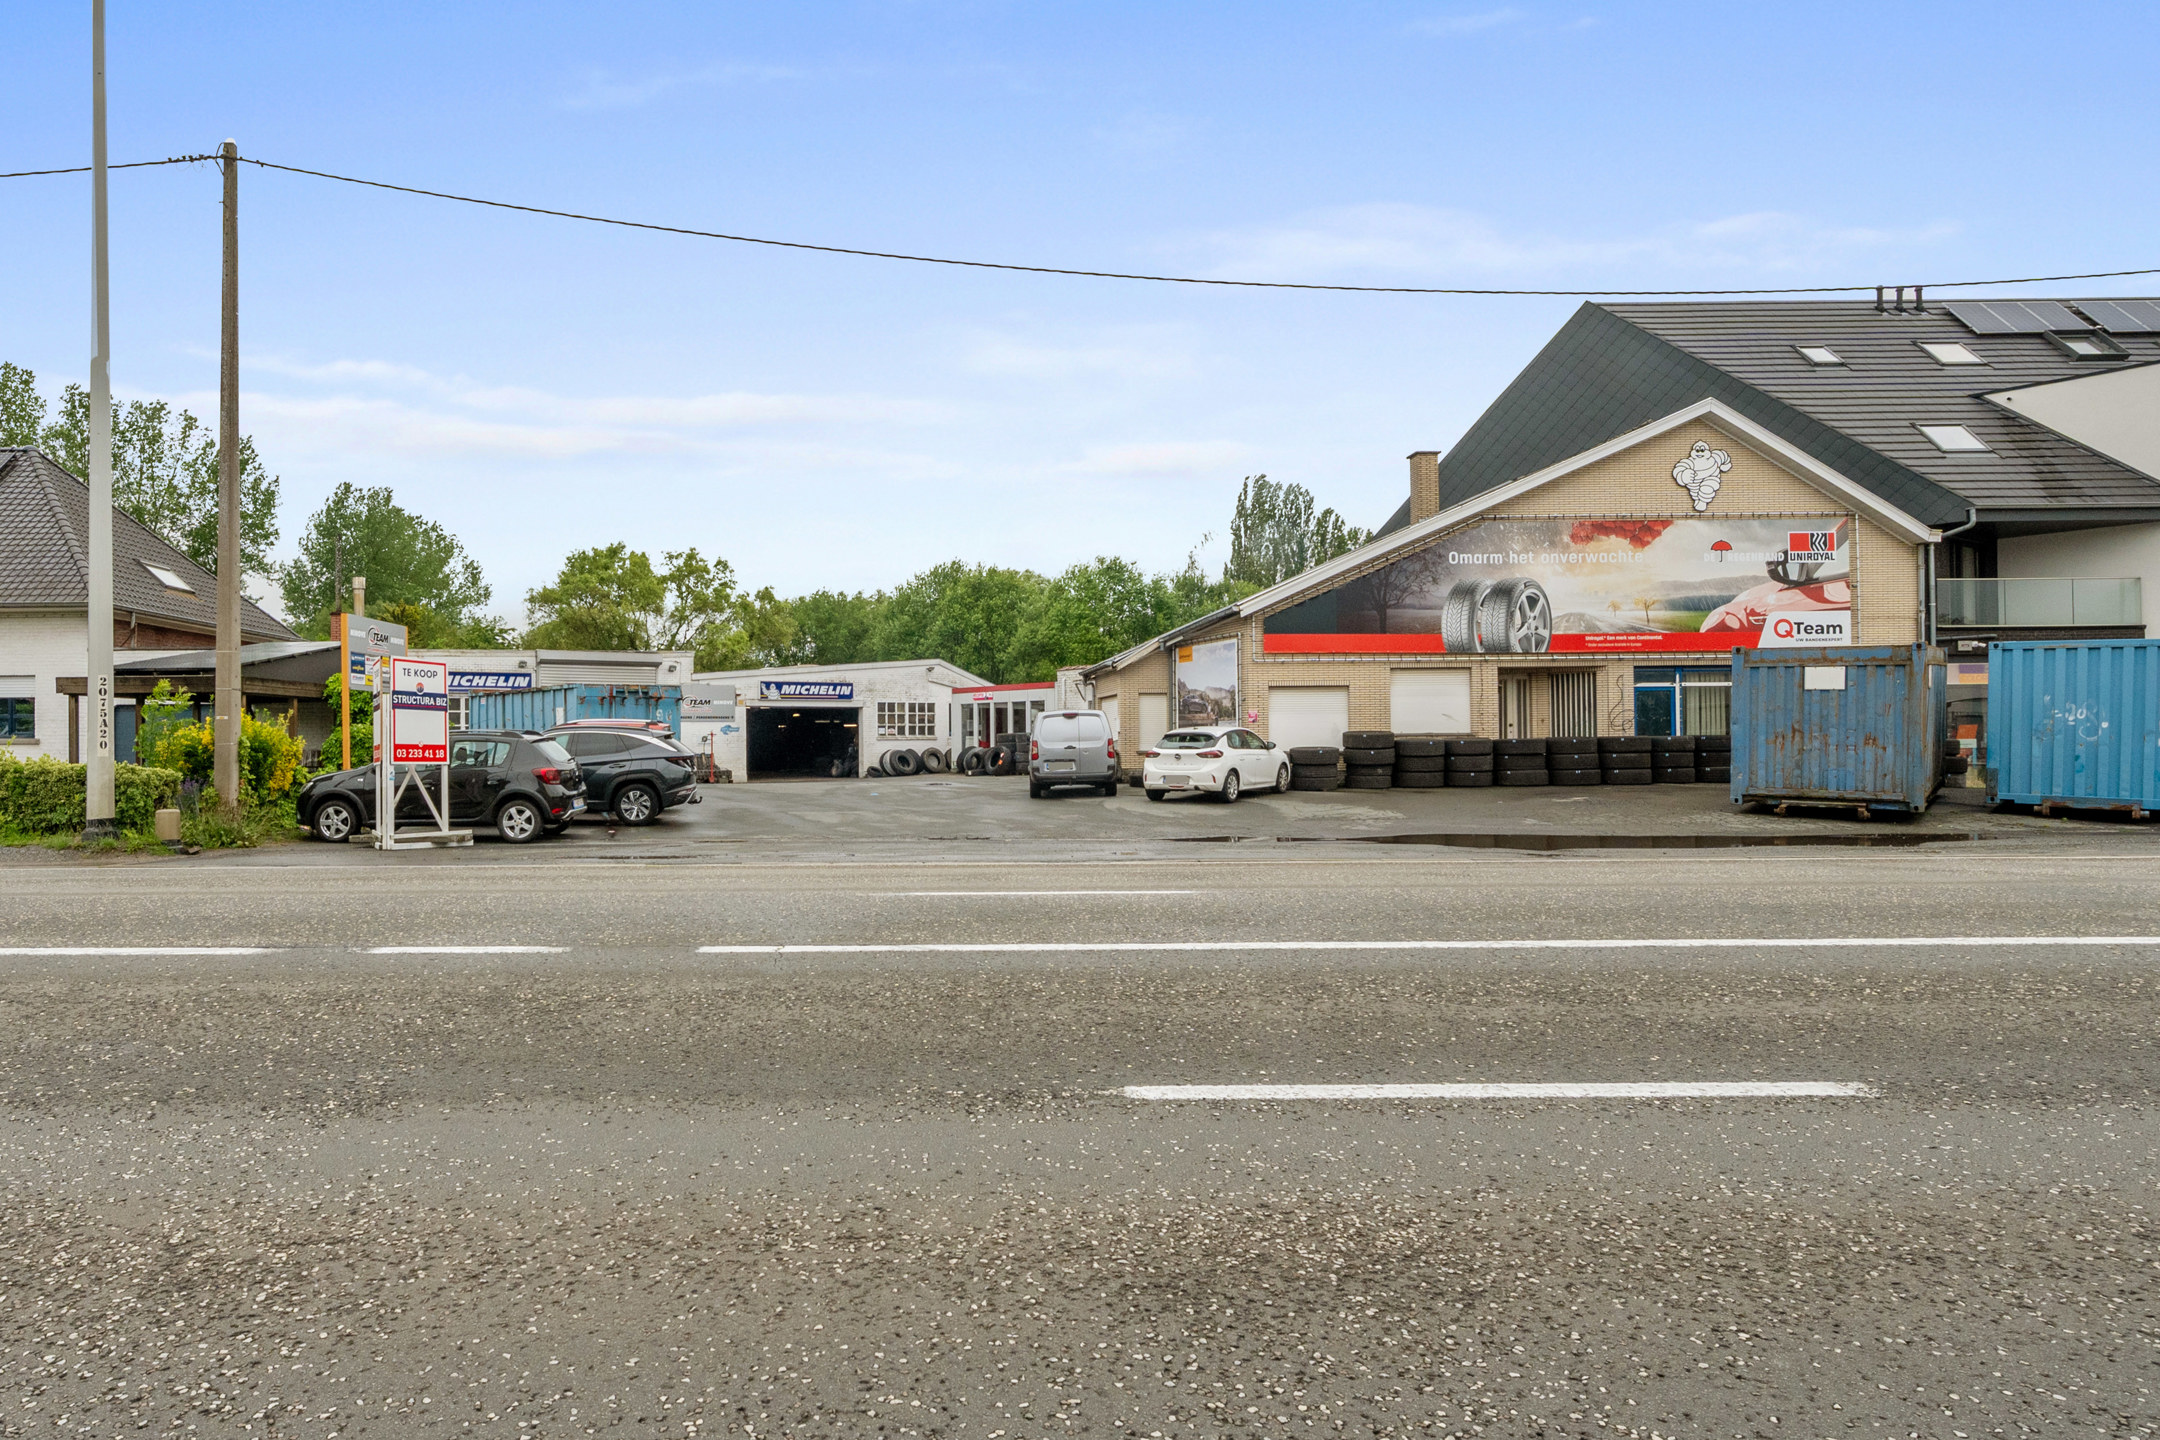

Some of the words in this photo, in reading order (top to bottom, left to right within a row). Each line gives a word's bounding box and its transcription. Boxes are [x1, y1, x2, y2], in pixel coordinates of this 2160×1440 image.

[1448, 551, 1504, 565] Omarm
[1509, 551, 1535, 565] het
[1540, 550, 1644, 565] onverwachte
[1703, 552, 1716, 562] DE
[1727, 552, 1785, 562] REGENBAND
[1789, 552, 1836, 561] UNIROYAL
[402, 667, 412, 677] TE
[414, 669, 438, 679] KOOP
[781, 685, 852, 695] MICHELIN
[393, 694, 435, 706] STRUCTURA
[436, 697, 447, 706] BIZ
[396, 749, 407, 758] 03
[408, 749, 423, 758] 233
[424, 749, 433, 758] 41
[435, 749, 445, 758] 18
